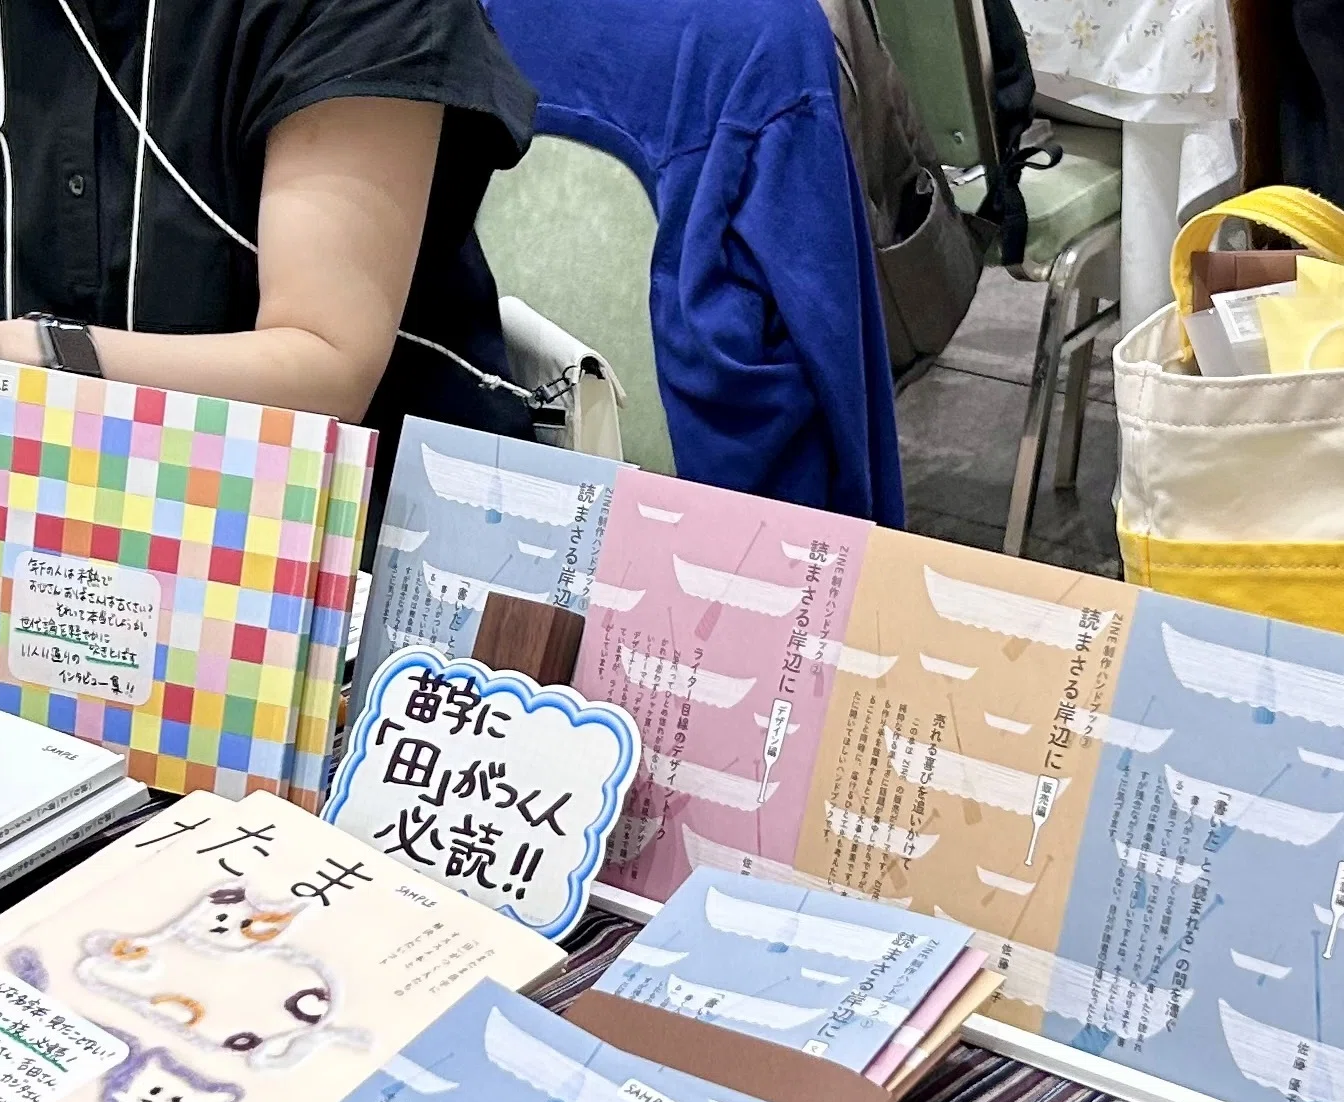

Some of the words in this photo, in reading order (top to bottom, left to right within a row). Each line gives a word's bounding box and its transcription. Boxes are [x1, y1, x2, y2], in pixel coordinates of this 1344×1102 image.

[778, 538, 830, 695] 読まさる岸辺に
[404, 668, 513, 739] 苗字に
[1044, 605, 1101, 772] 読まさる岸辺に
[41, 744, 80, 761] SAMPLE
[375, 717, 574, 838] 「田」がつく人
[897, 712, 947, 872] 売れる喜びを追いかけて
[196, 822, 374, 908] たま
[373, 805, 544, 902] 必読!!
[395, 885, 438, 908] SAMPLE
[817, 930, 920, 1039] 読まさる岸辺に
